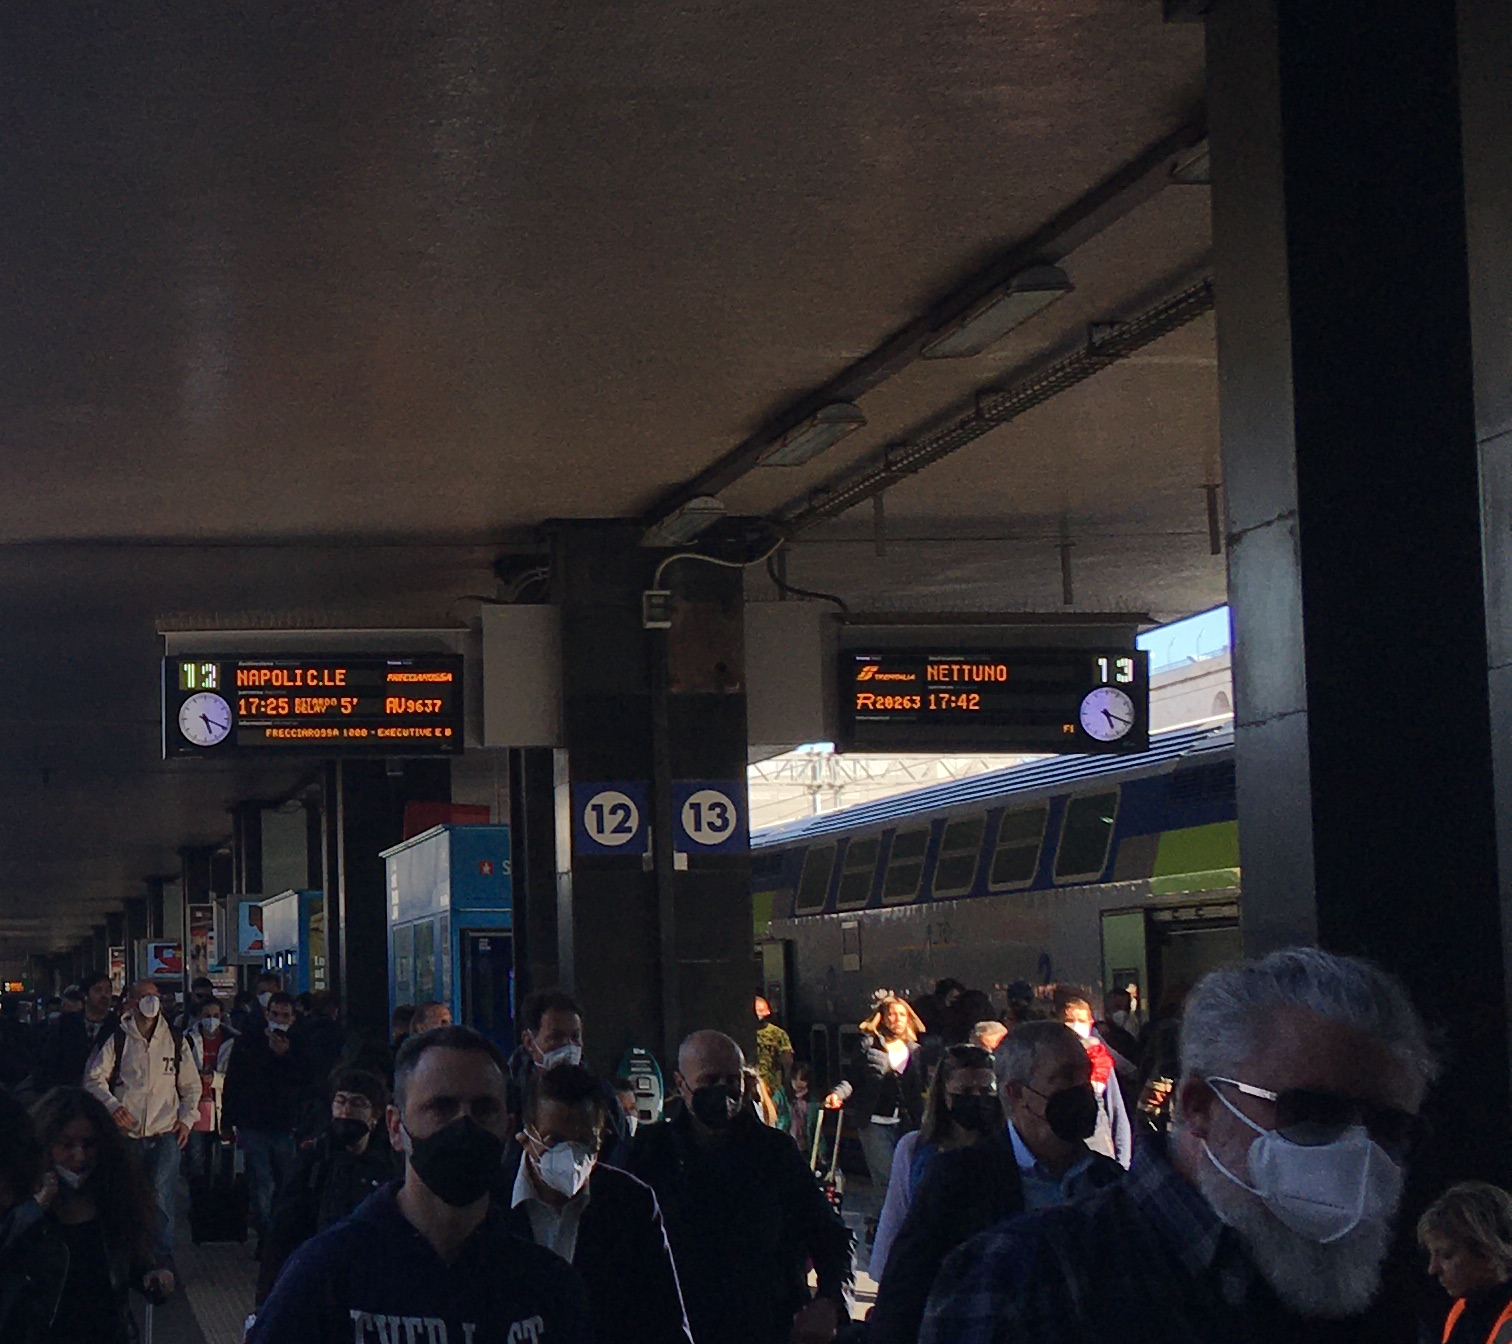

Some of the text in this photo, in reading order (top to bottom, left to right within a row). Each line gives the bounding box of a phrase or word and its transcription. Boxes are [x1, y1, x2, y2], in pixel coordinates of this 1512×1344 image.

[183, 663, 216, 688] 12
[236, 669, 346, 686] NAPOLI C.LE
[926, 665, 1008, 682] NETTUNO
[1097, 658, 1133, 683] 13
[239, 698, 288, 714] 17:25
[294, 697, 338, 706] RITARDO
[294, 705, 327, 714] DELAY
[340, 698, 358, 714] 5'
[928, 693, 981, 710] 17:42
[343, 728, 368, 738] 1000
[377, 728, 432, 738] EXECUTIVE
[435, 728, 443, 737] E
[591, 803, 633, 834] 12
[689, 802, 729, 832] 13
